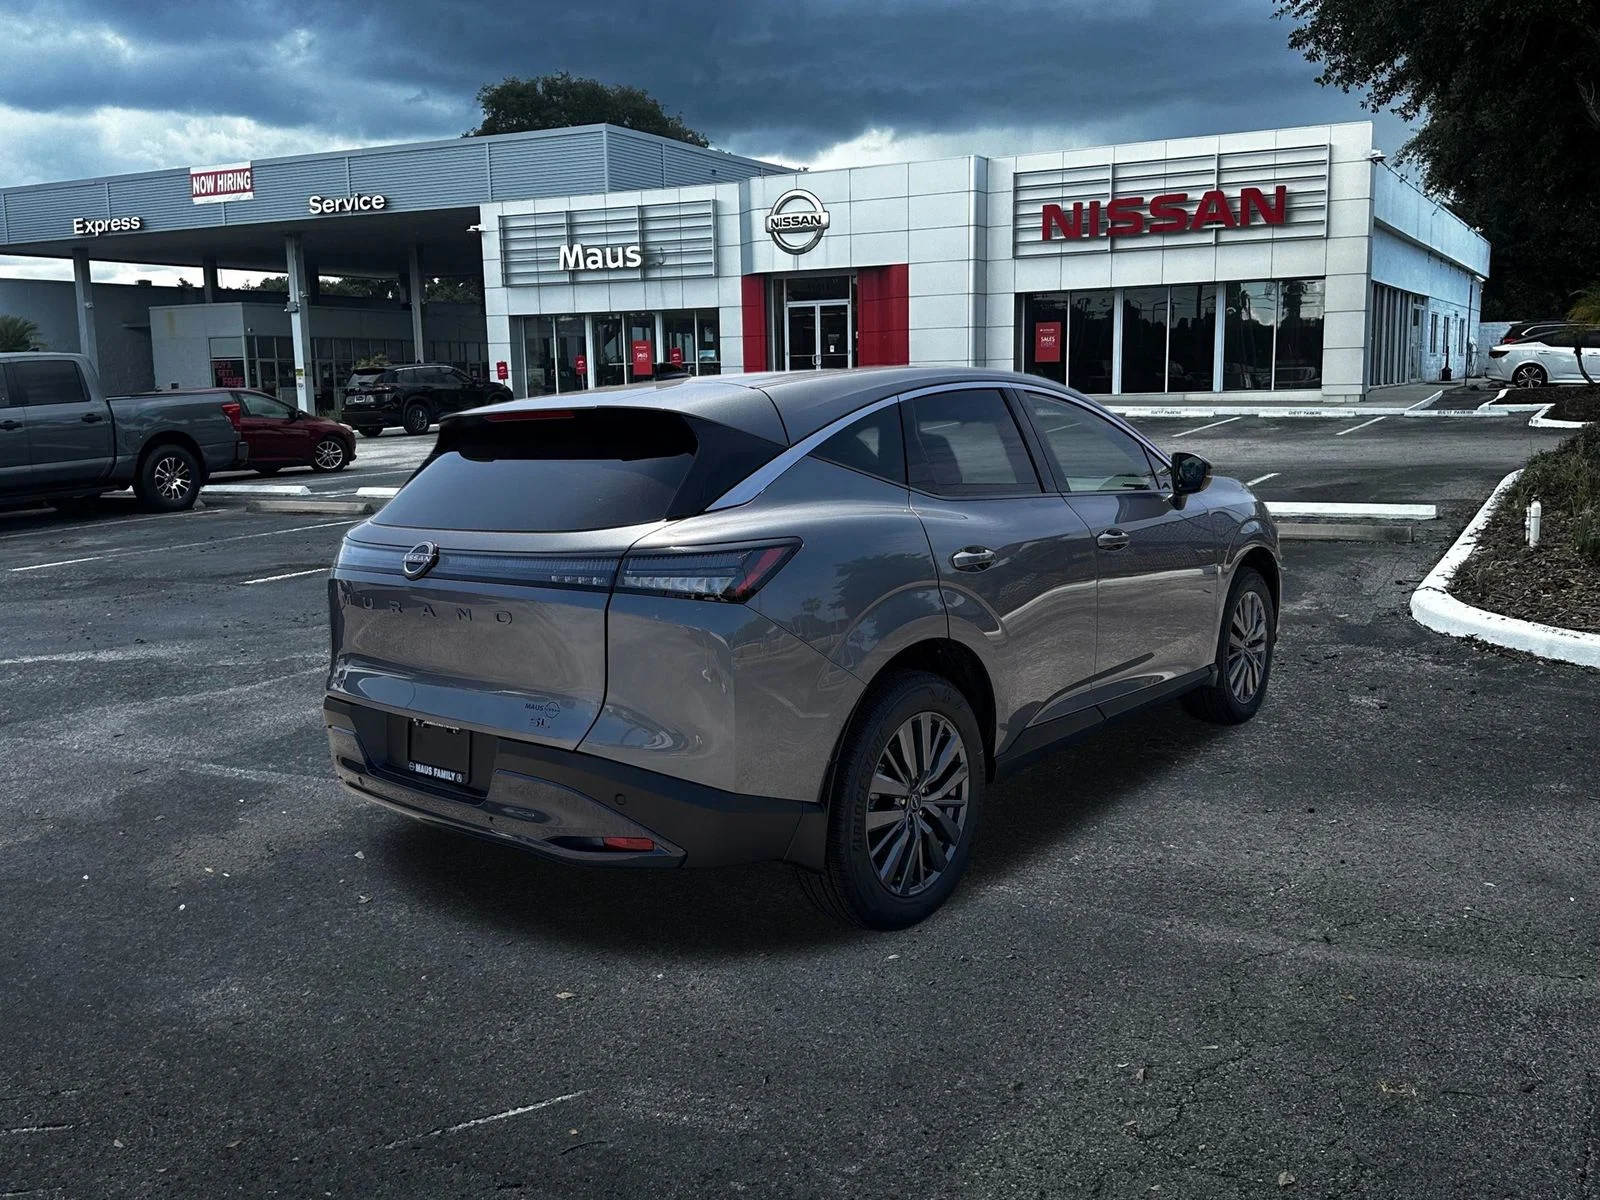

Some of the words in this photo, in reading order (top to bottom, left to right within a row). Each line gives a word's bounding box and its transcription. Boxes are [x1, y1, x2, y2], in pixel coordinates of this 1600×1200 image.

[192, 174, 215, 195] NOW
[217, 170, 251, 193] HIRING
[308, 192, 385, 214] Service
[1042, 185, 1287, 241] NISSAN
[73, 216, 141, 237] Express
[770, 214, 822, 228] NISSAN
[559, 243, 642, 271] Maus
[338, 591, 513, 626] MURANO
[524, 703, 544, 712] MAUS
[415, 763, 433, 776] MAUS
[433, 767, 456, 781] FAMILY
